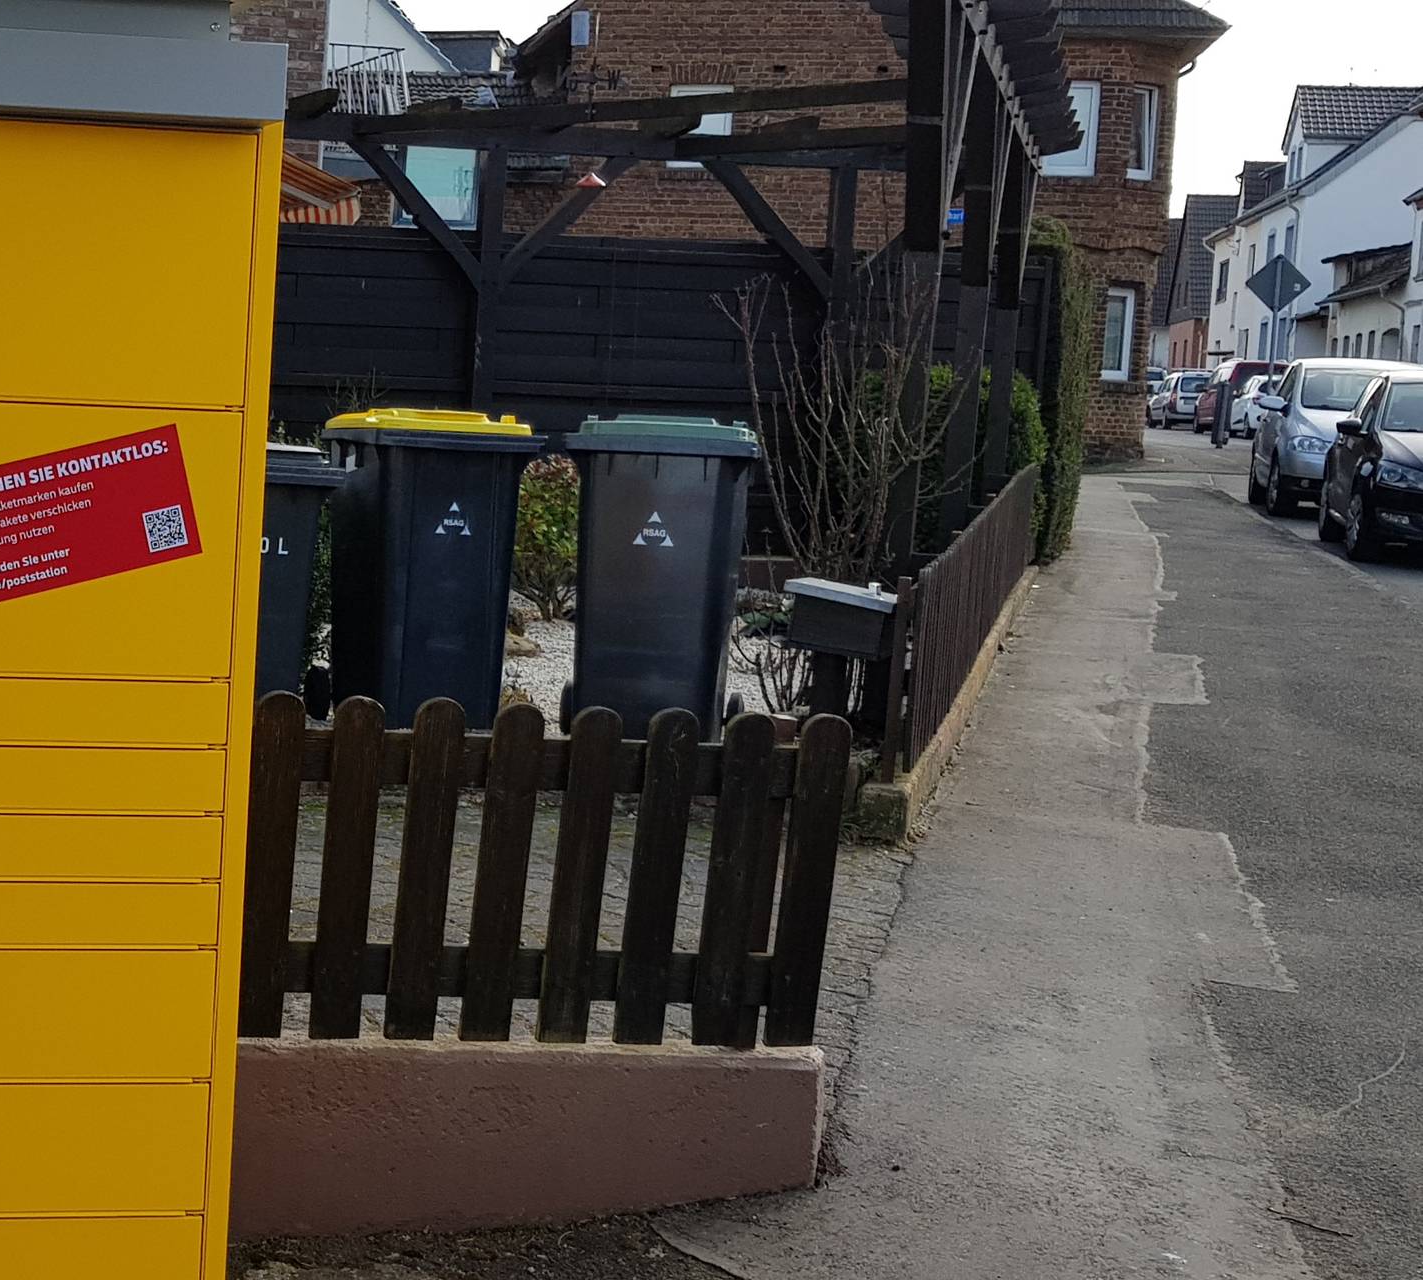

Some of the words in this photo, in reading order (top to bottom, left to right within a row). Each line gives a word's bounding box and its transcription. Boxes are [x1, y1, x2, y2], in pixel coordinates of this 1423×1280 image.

[28, 465, 55, 484] SIE
[56, 440, 169, 478] KONTAKTLOS:
[59, 480, 95, 497] kaufen
[30, 498, 92, 521] verschicken
[19, 523, 55, 540] nutzen
[642, 527, 666, 538] RSAG
[22, 554, 40, 568] Sie
[41, 547, 71, 563] unter
